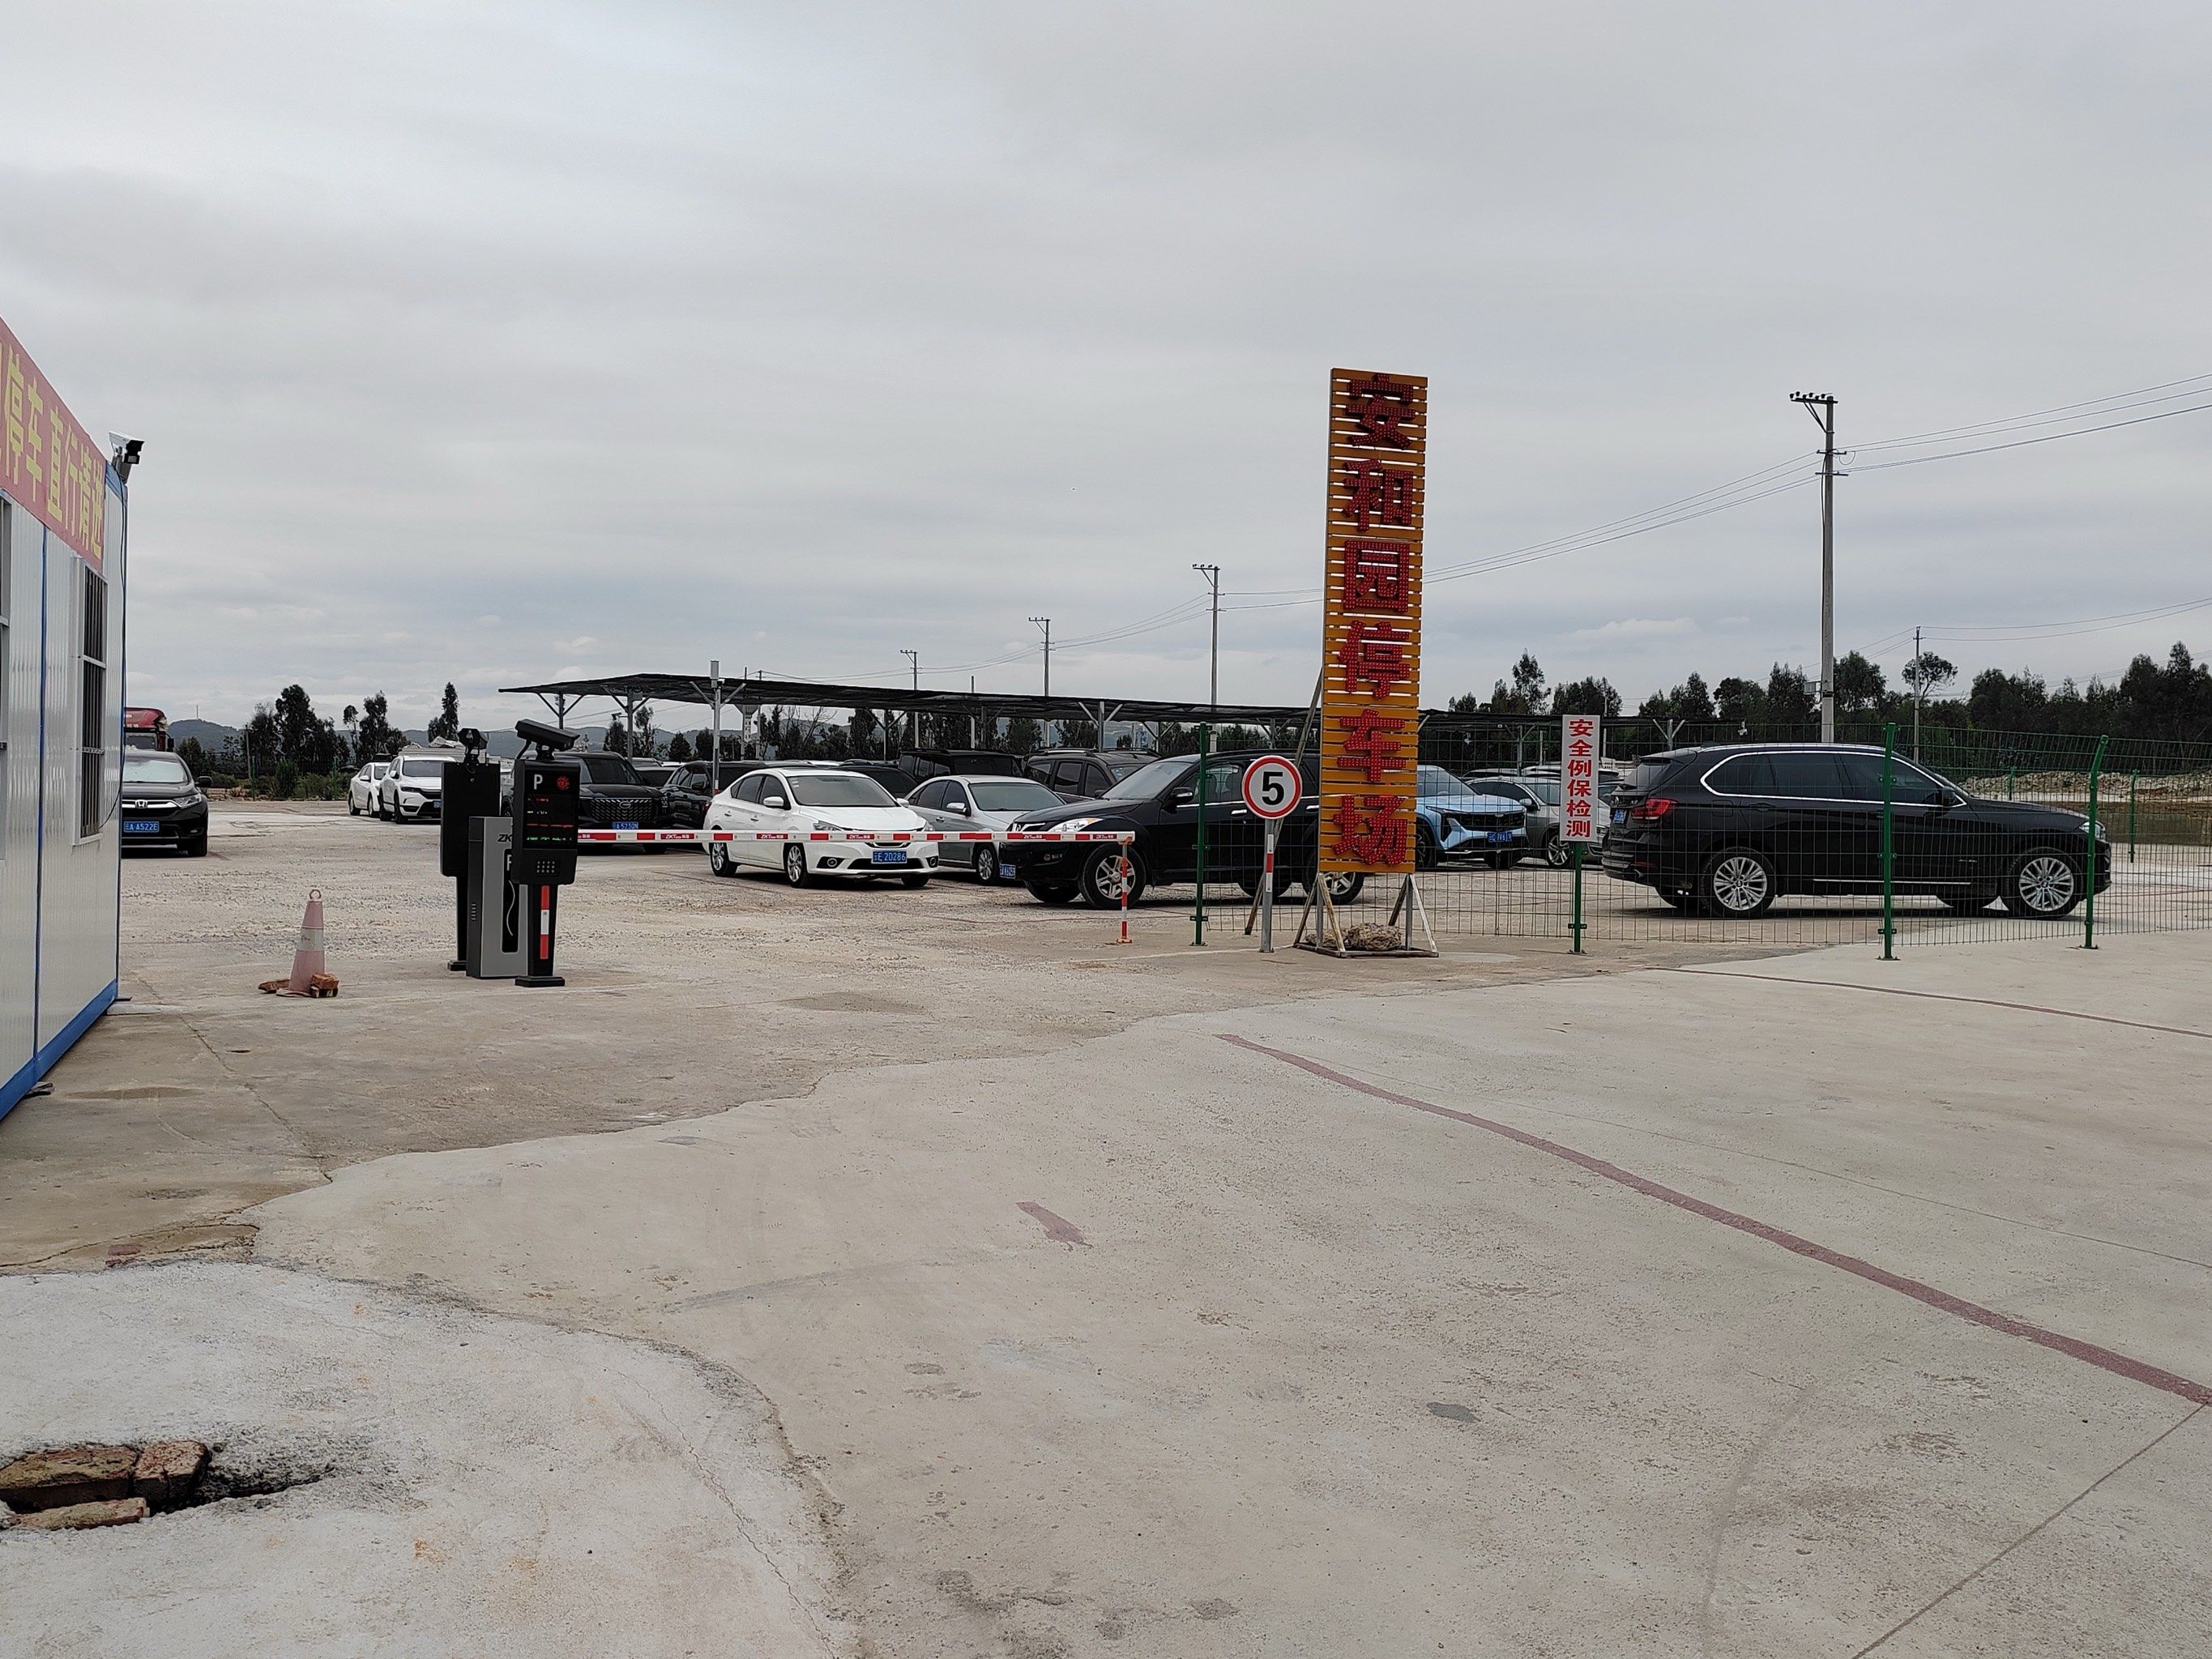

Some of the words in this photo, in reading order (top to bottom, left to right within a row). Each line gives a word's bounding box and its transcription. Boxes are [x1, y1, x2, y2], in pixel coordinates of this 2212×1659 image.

[1333, 373, 1416, 866] 安和园停车场
[533, 774, 544, 791] P
[1262, 770, 1285, 806] 5
[1565, 719, 1594, 838] 安全例保检测
